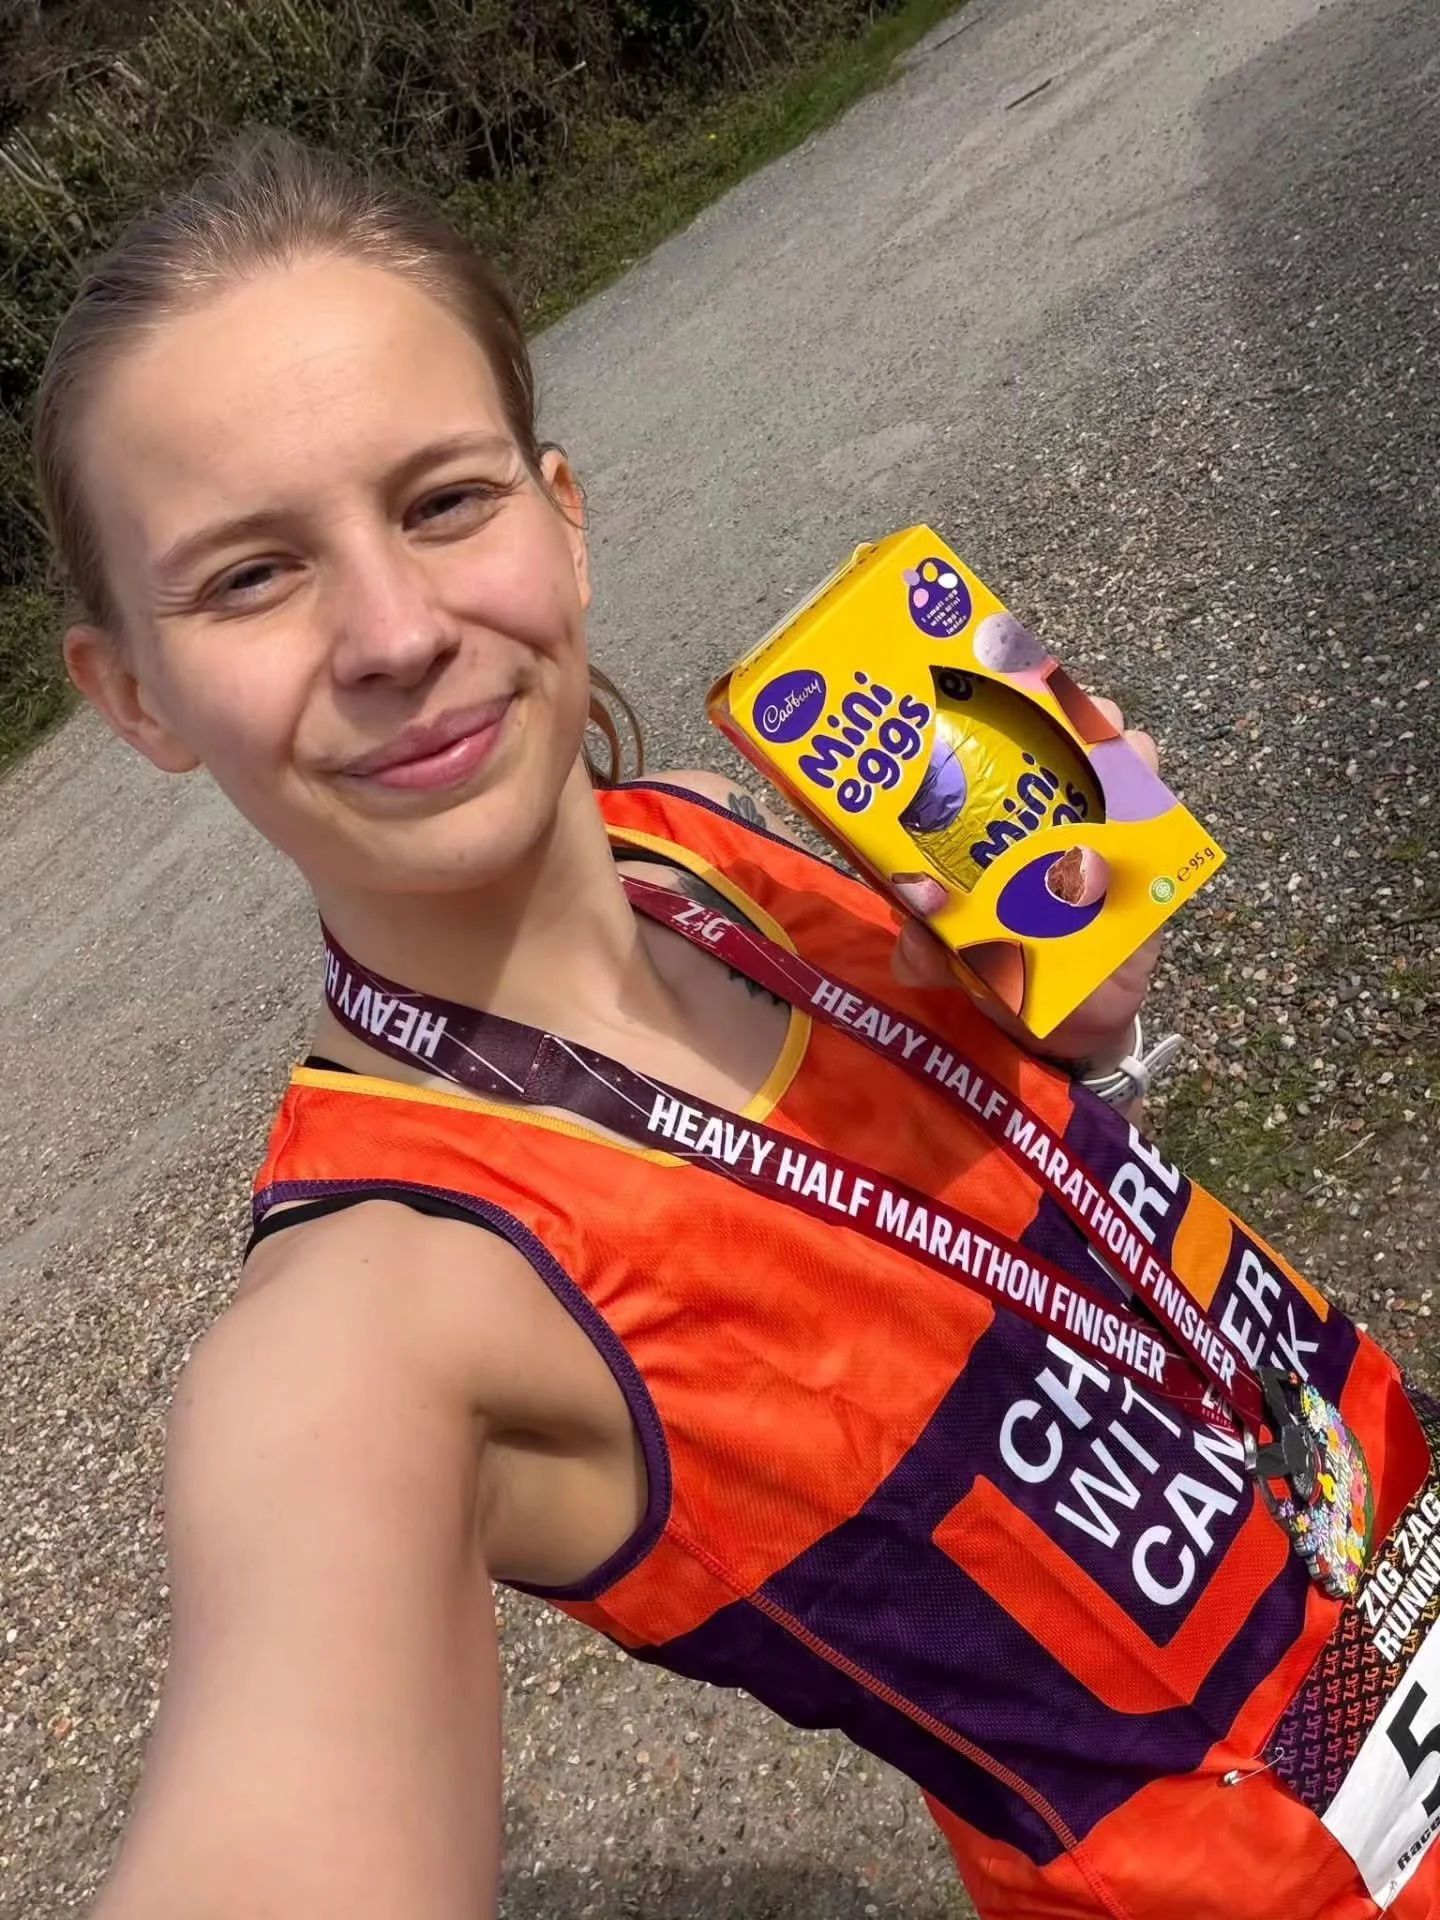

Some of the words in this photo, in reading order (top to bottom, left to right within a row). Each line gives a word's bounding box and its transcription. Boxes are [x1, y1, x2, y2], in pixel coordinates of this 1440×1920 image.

[762, 678, 822, 733] Cadbury
[837, 694, 931, 814] eggs
[1188, 852, 1205, 871] 95
[337, 971, 449, 1059] HEAVY
[647, 1093, 776, 1177] HEAVY
[775, 1147, 876, 1218] HALF
[874, 1189, 1050, 1315] MARATHON
[1049, 1281, 1167, 1384] FINISHER
[810, 978, 928, 1060] HEAVY
[923, 1045, 1009, 1121] HALF
[1003, 1108, 1145, 1275] MARATHON
[1140, 1255, 1237, 1396] FINISHER
[1055, 1376, 1182, 1549] WIT
[1355, 1560, 1404, 1628] ZIG
[1392, 1491, 1440, 1568] ZAG
